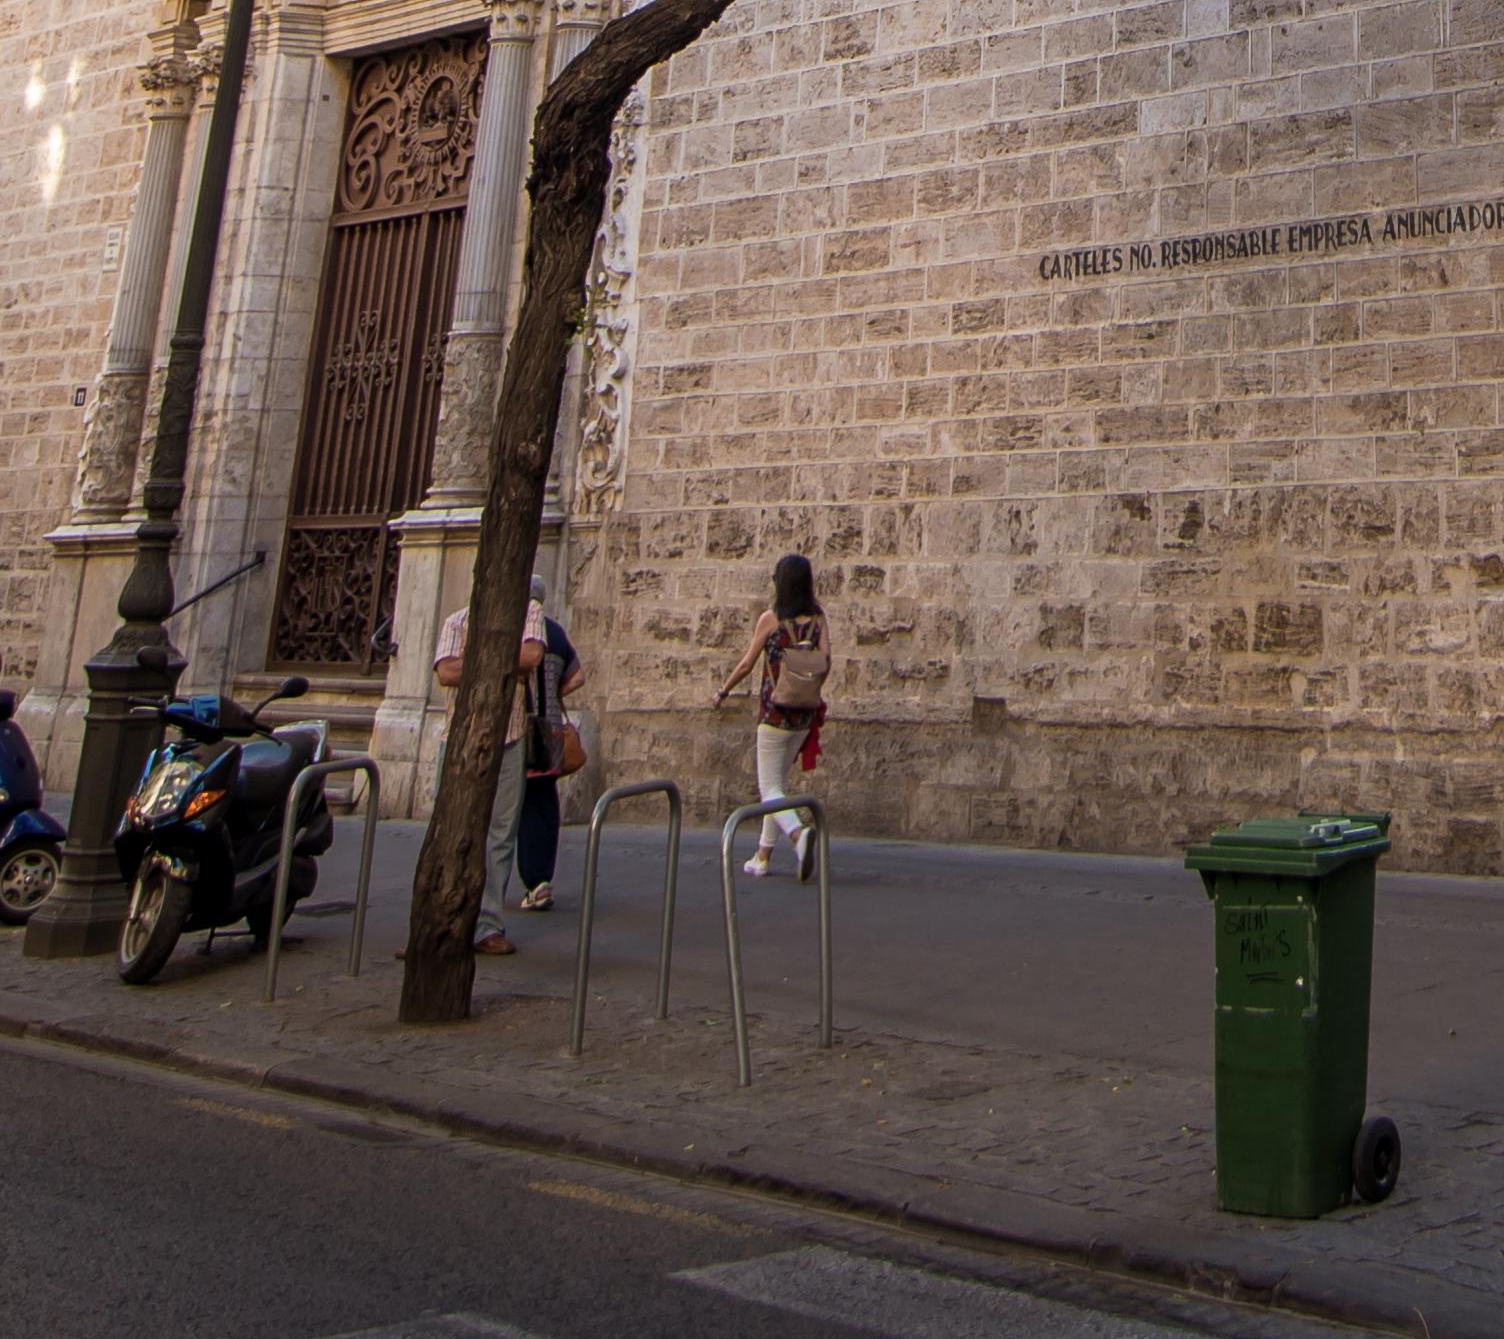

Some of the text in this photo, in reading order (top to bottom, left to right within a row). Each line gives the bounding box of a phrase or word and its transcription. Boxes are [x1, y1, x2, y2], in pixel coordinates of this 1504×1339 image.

[1039, 247, 1123, 281] CARTELES
[1129, 243, 1156, 271] NO.
[1160, 227, 1280, 270] RESPONSABLE
[1288, 217, 1374, 253] EMPRESA
